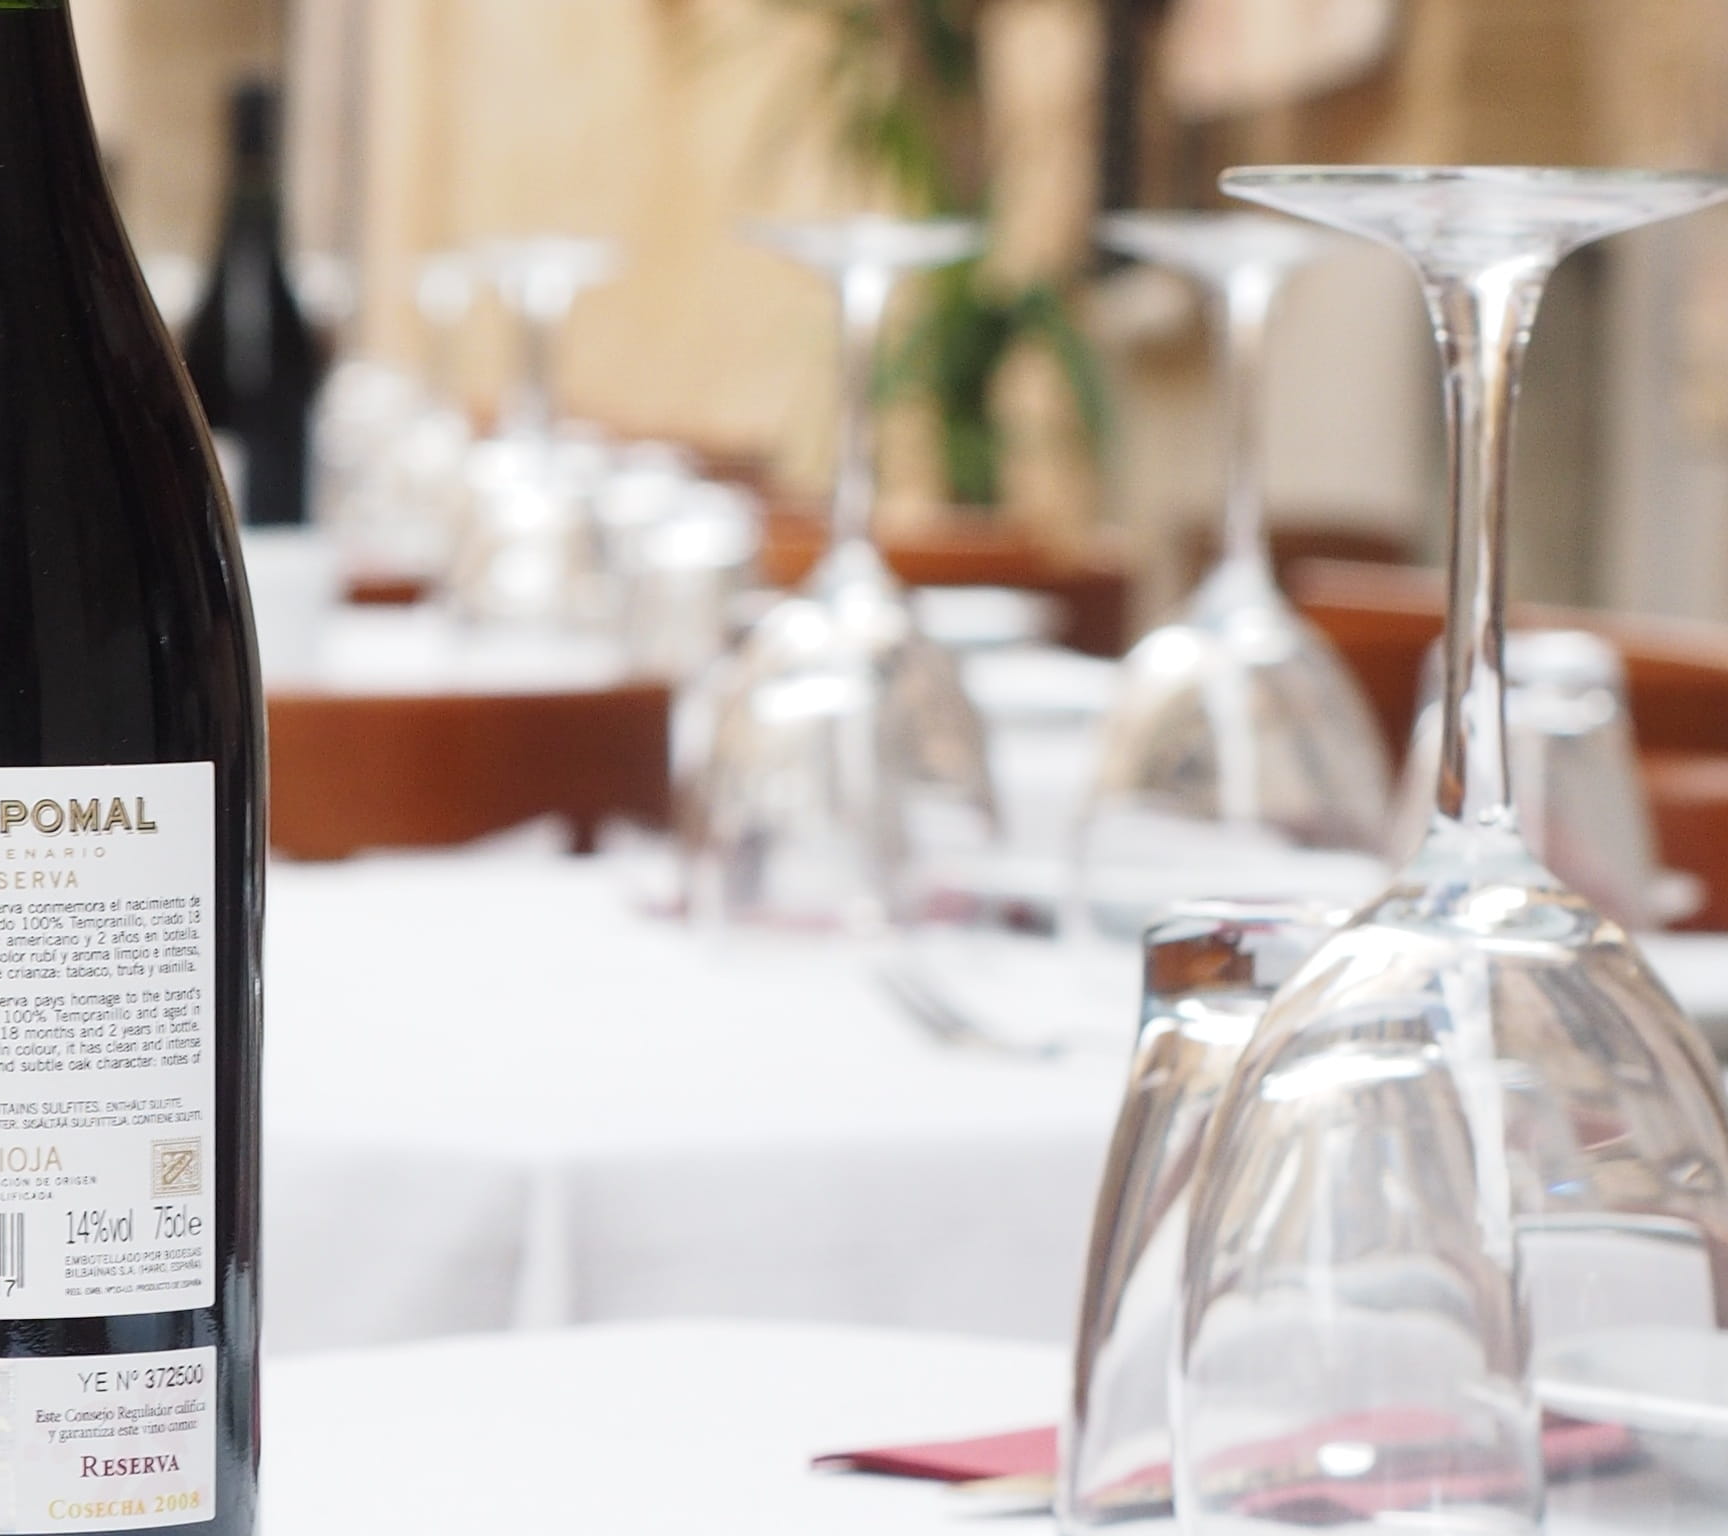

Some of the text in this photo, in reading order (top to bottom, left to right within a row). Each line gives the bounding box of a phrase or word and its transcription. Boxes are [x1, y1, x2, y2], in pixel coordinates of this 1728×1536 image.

[0, 796, 158, 834] POMAL
[28, 903, 105, 914] conmemora
[110, 899, 120, 912] el
[126, 897, 185, 910] nacimiento
[189, 896, 201, 908] de
[23, 916, 63, 930] 100%
[70, 915, 146, 929] Tempranillo,
[152, 913, 184, 926] criado
[189, 911, 201, 923] 18
[6, 934, 78, 946] americano
[84, 936, 91, 947] y
[97, 932, 106, 944] 2
[112, 931, 139, 943] años
[145, 931, 159, 942] en
[30, 948, 56, 961] rubí
[60, 952, 69, 964] y
[72, 950, 110, 961] aroma
[114, 947, 150, 960] limpio
[153, 948, 159, 958] e
[7, 967, 61, 979] crianza:
[66, 967, 112, 978] tabaco,
[117, 963, 145, 976] trufa
[148, 965, 155, 977] y
[34, 995, 64, 1009] pays
[71, 993, 120, 1007] homage
[126, 992, 136, 1003] to
[142, 991, 160, 1003] the
[5, 1010, 47, 1023] 100%
[54, 1007, 130, 1023] Tempranillo
[136, 1007, 157, 1019] and
[163, 1005, 187, 1020] aged
[193, 1004, 201, 1015] in
[2, 1027, 19, 1040] 18
[24, 1026, 74, 1039] months
[80, 1026, 103, 1038] and
[109, 1024, 117, 1037] 2
[122, 1025, 151, 1038] years
[155, 1023, 165, 1034] in
[15, 1043, 60, 1056] colour,
[66, 1042, 75, 1055] it
[80, 1041, 101, 1054] has
[106, 1039, 137, 1052] clean
[142, 1038, 162, 1050] and
[166, 1037, 201, 1049] intense
[20, 1059, 63, 1072] subtle
[69, 1058, 91, 1071] oak
[161, 1055, 188, 1066] notes
[193, 1052, 201, 1063] of
[36, 1177, 50, 1186] DE
[55, 1176, 97, 1186] ORIGEN
[78, 1372, 108, 1392] YE
[145, 1364, 204, 1388] 372500
[36, 1400, 205, 1426] Este Consejo Regulador califica
[48, 1424, 164, 1443] y garantiza este vino
[80, 1454, 180, 1478] RESERVA
[48, 1491, 200, 1519] COSECHA 2008
